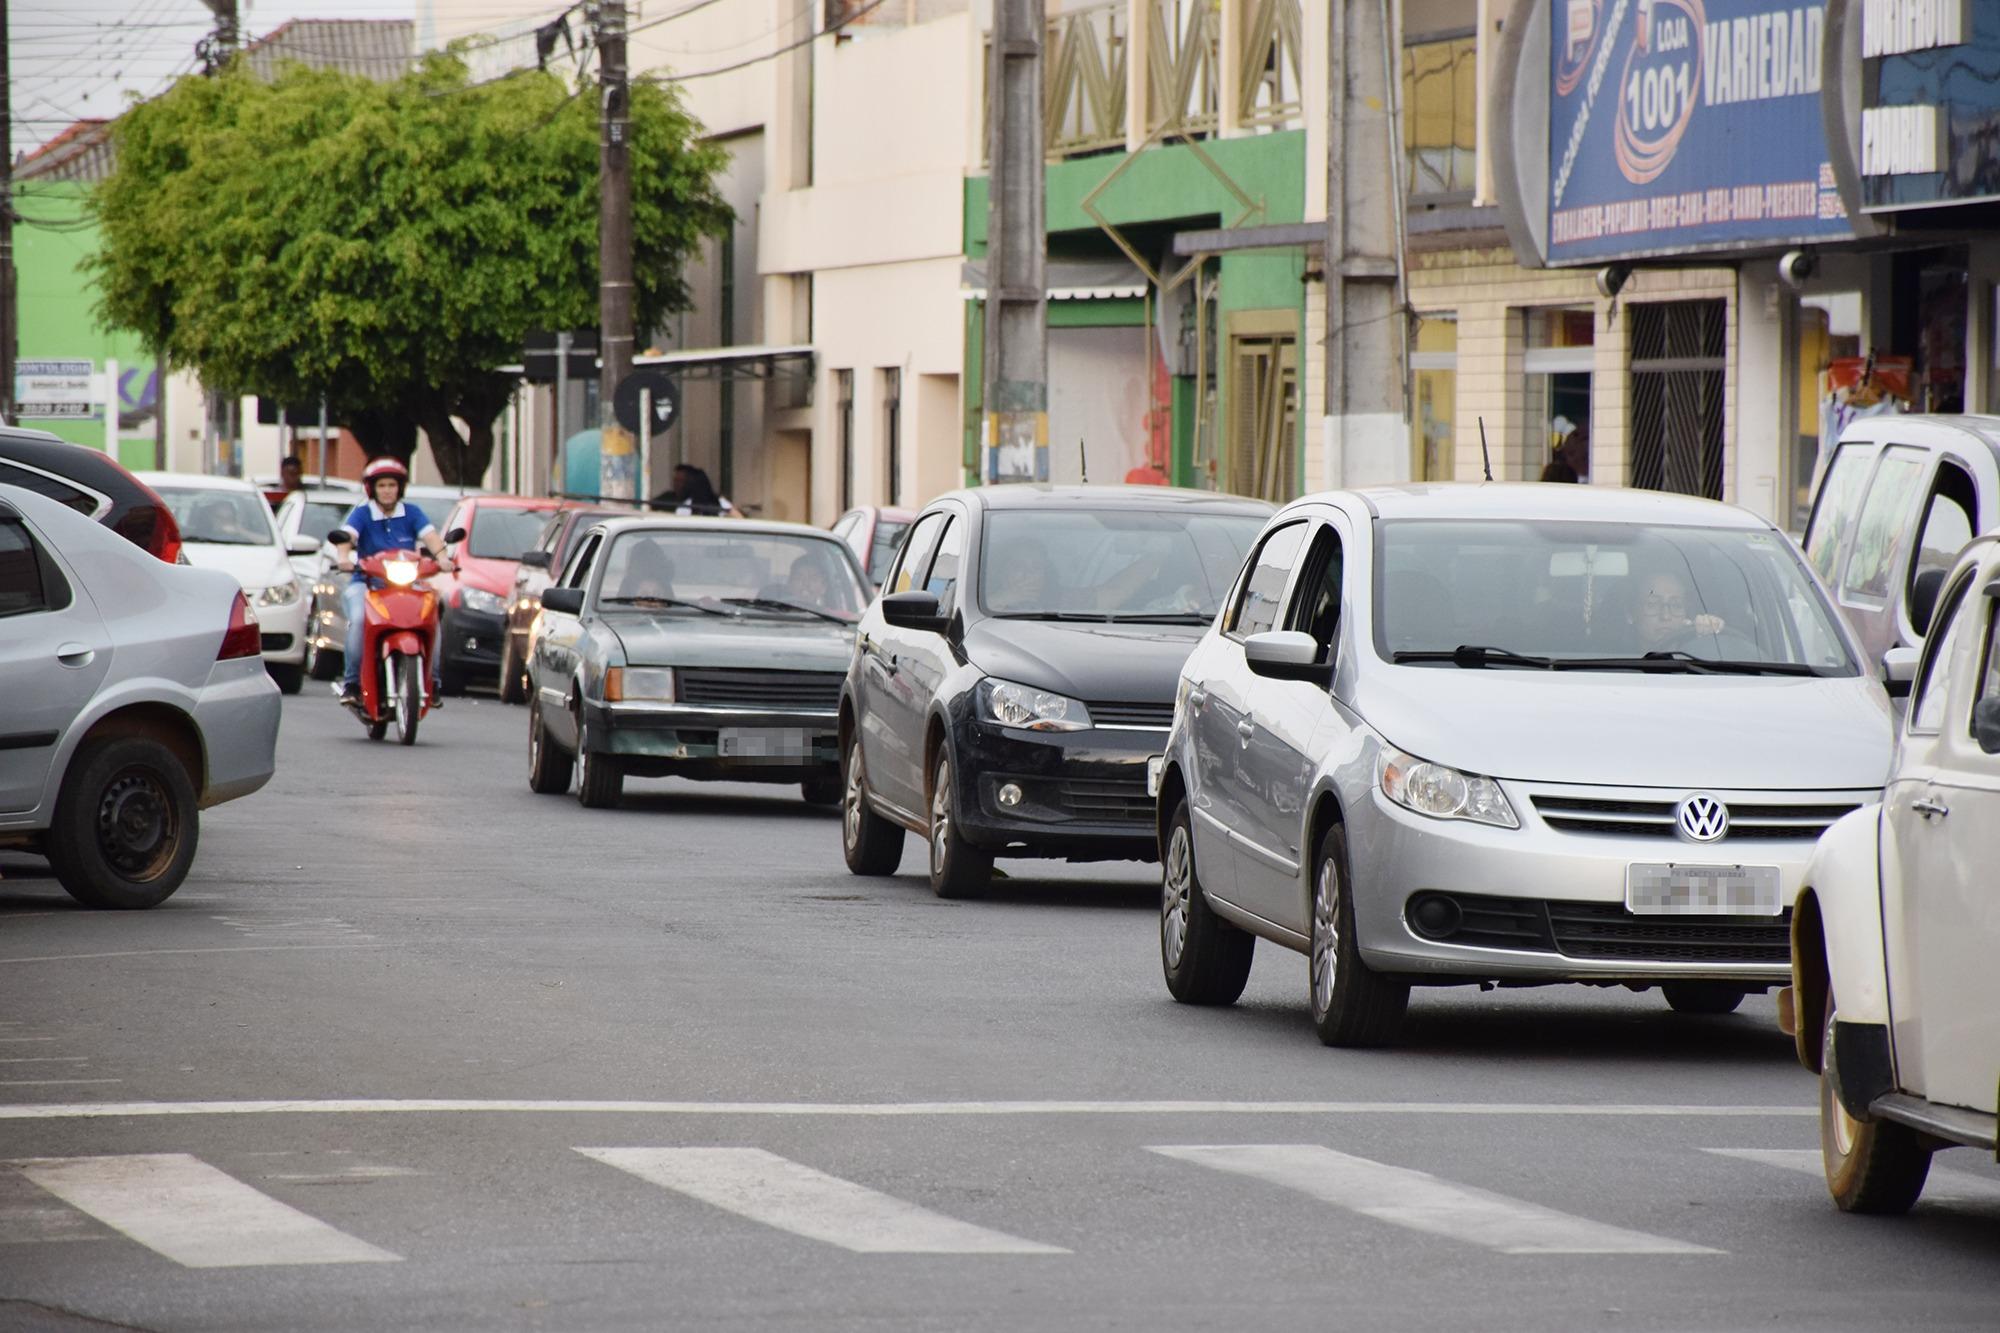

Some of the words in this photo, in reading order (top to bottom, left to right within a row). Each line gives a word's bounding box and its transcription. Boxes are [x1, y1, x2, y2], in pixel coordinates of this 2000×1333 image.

[1657, 17, 1689, 52] LOJA
[1628, 62, 1690, 131] 1001
[1680, 795, 1727, 840] VW
